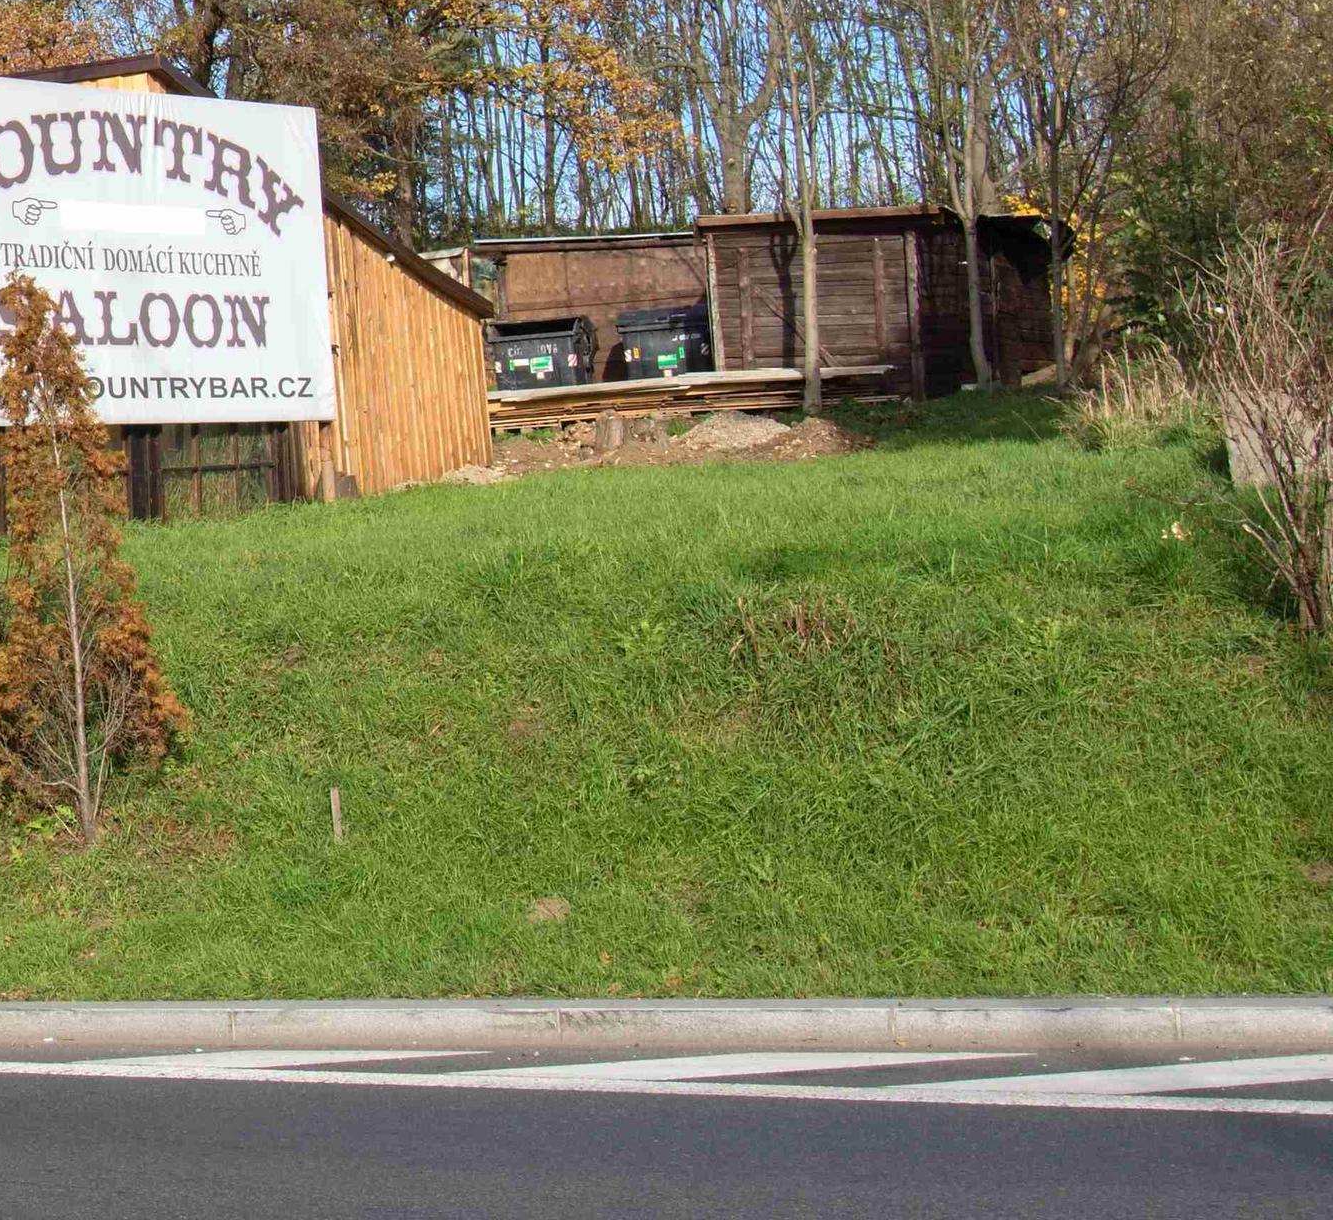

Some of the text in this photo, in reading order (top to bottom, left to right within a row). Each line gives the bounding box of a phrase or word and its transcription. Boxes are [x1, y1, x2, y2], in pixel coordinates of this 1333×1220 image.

[0, 240, 262, 277] TRADIČNÍ DOMÁCÍ KUCHYNĚ
